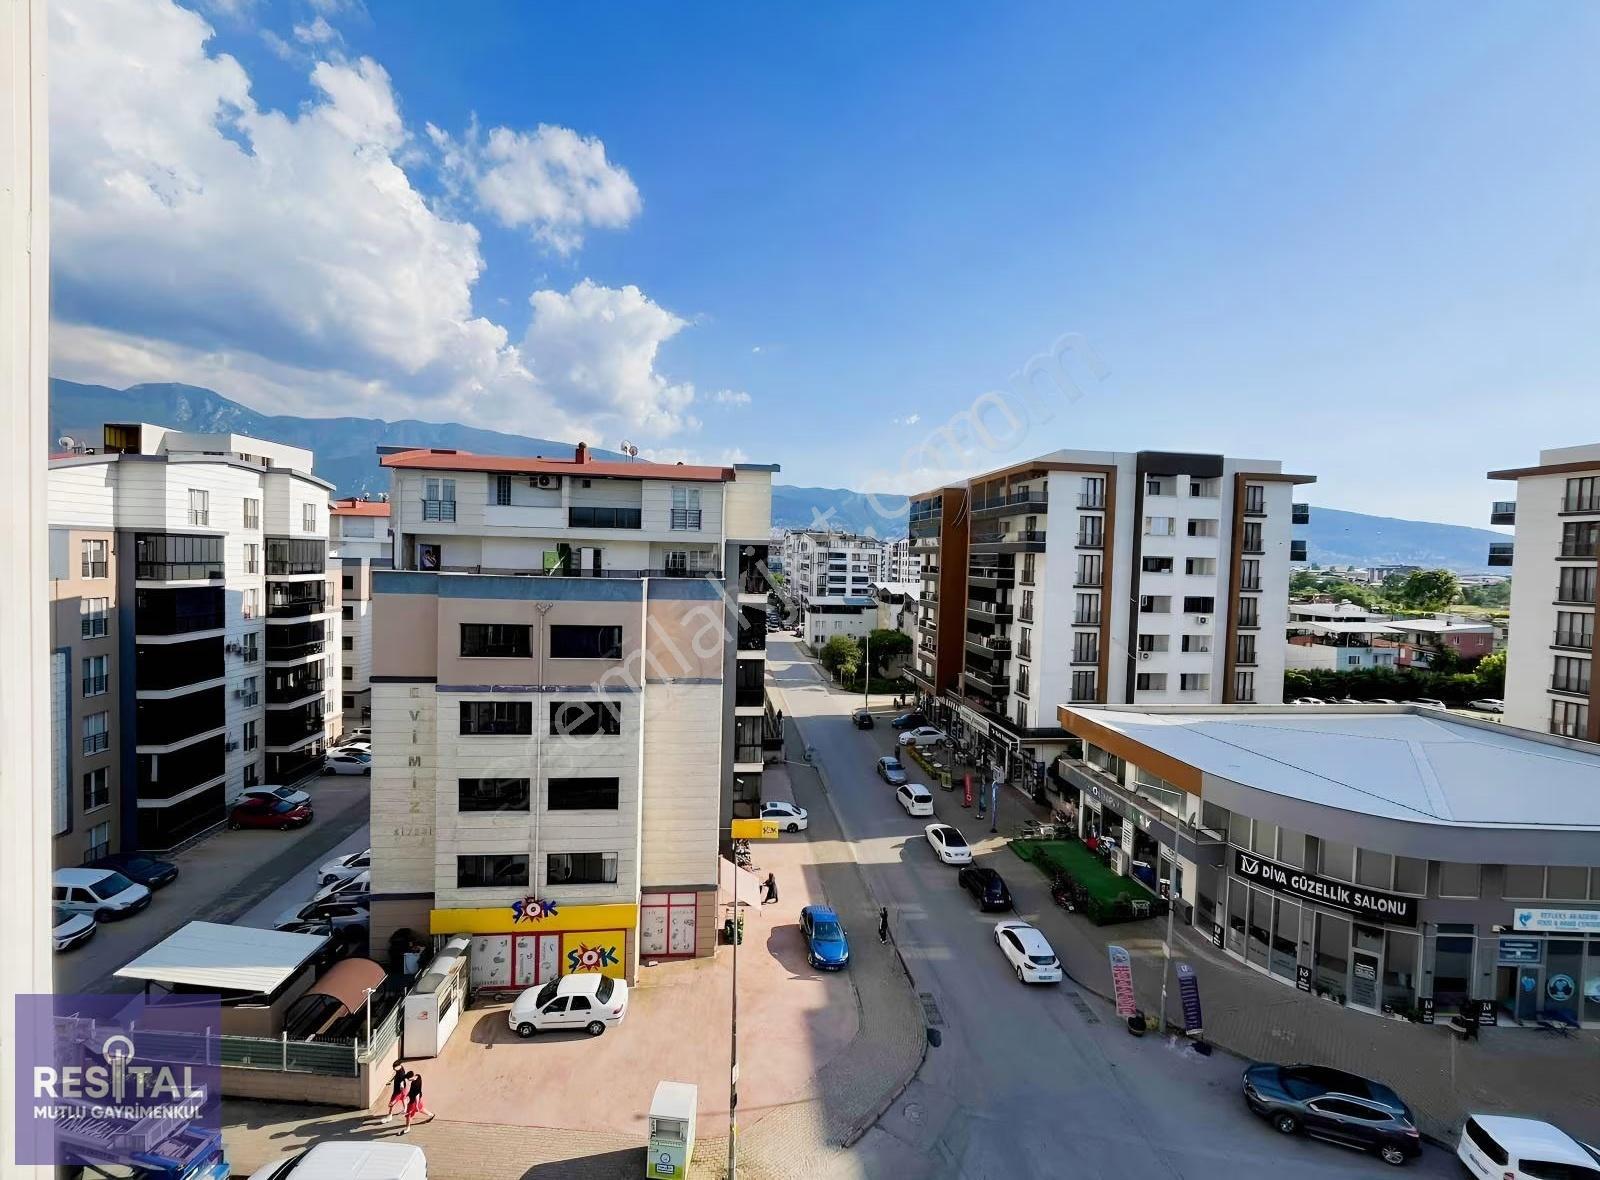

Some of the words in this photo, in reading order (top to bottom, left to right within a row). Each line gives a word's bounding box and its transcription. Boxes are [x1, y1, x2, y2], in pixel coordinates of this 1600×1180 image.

[1262, 865, 1288, 885] DİVA
[1291, 876, 1350, 904] GÜZELLİK
[1354, 893, 1407, 916] SALONU
